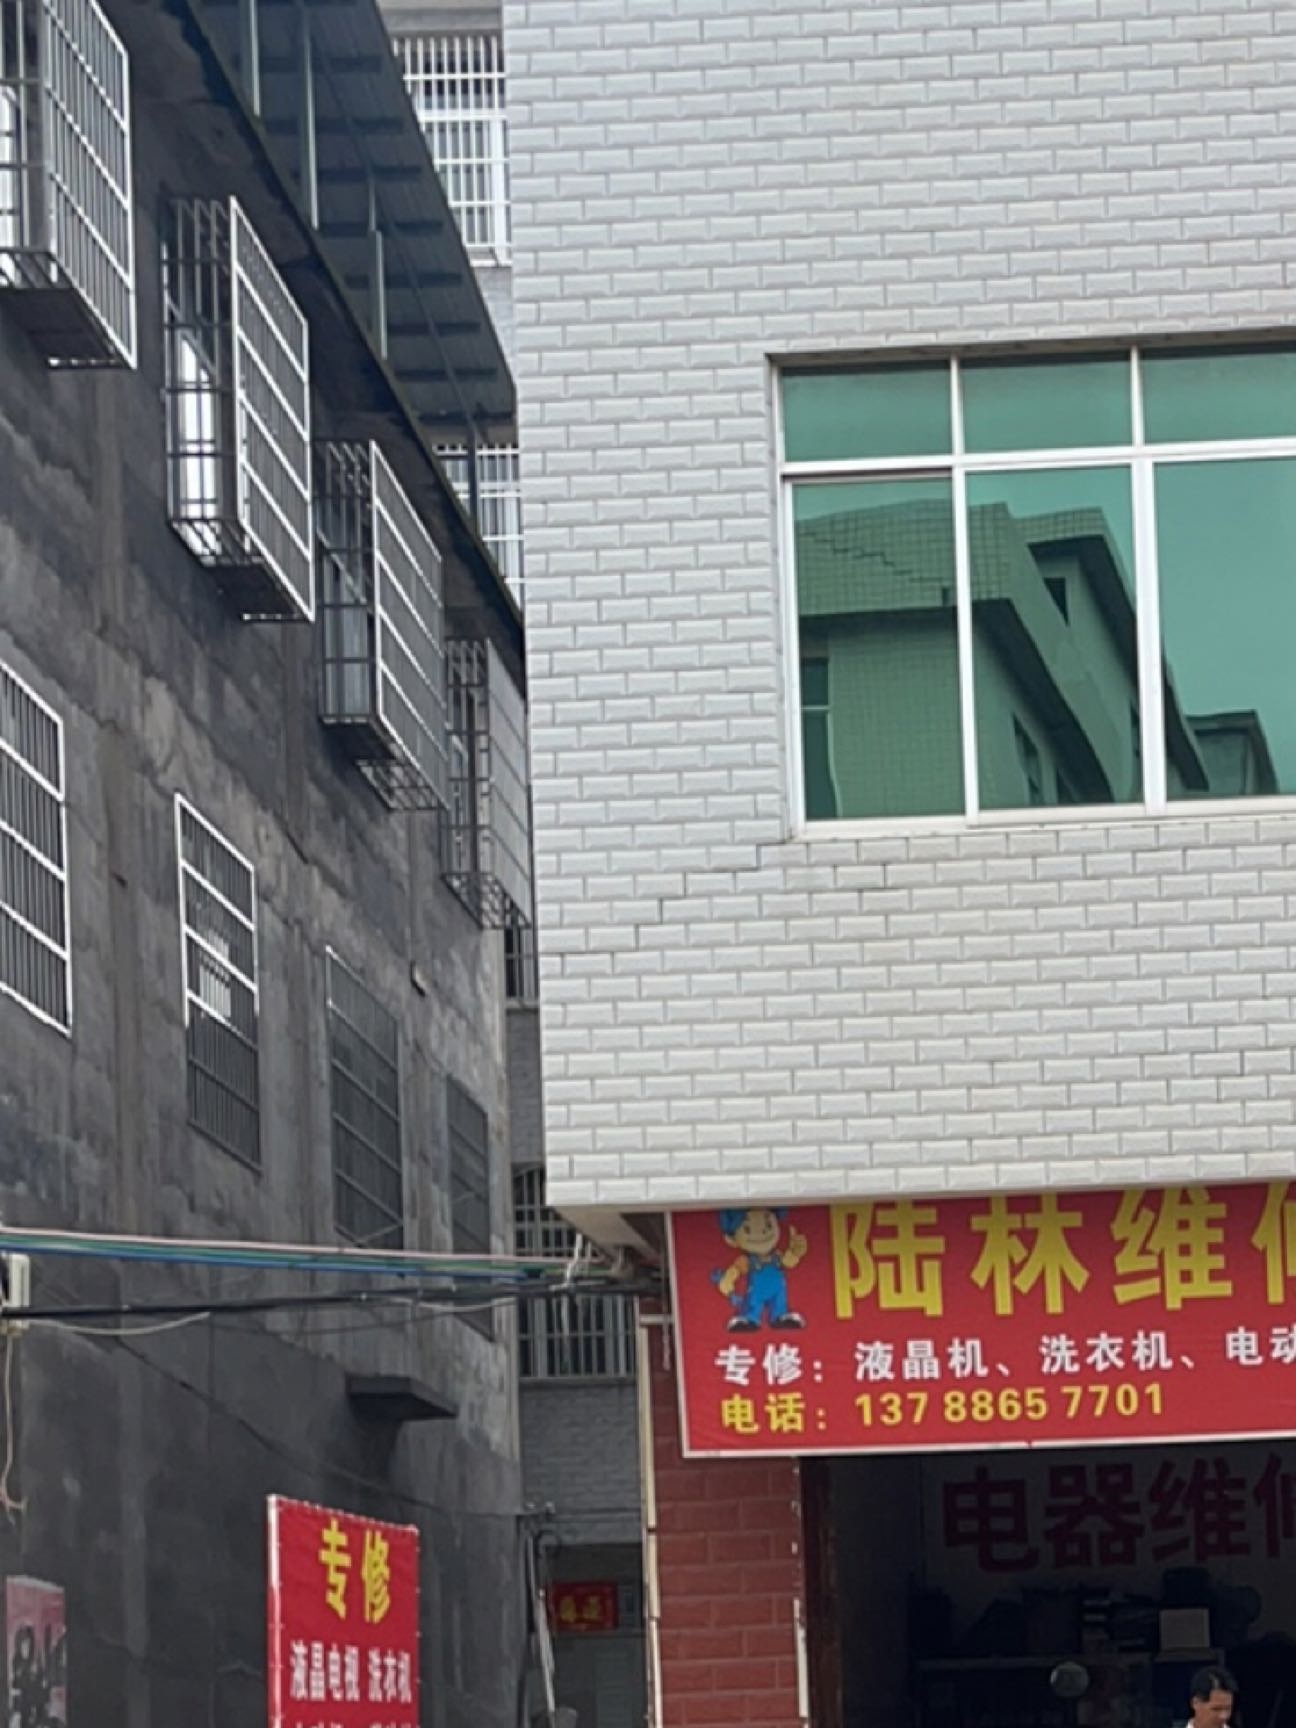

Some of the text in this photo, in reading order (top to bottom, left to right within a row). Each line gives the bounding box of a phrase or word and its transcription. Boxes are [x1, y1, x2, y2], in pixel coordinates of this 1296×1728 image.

[855, 1394, 928, 1426] 137
[945, 1389, 1050, 1422] 8865
[1064, 1383, 1165, 1417] 7701
[319, 1519, 391, 1623] 专修
